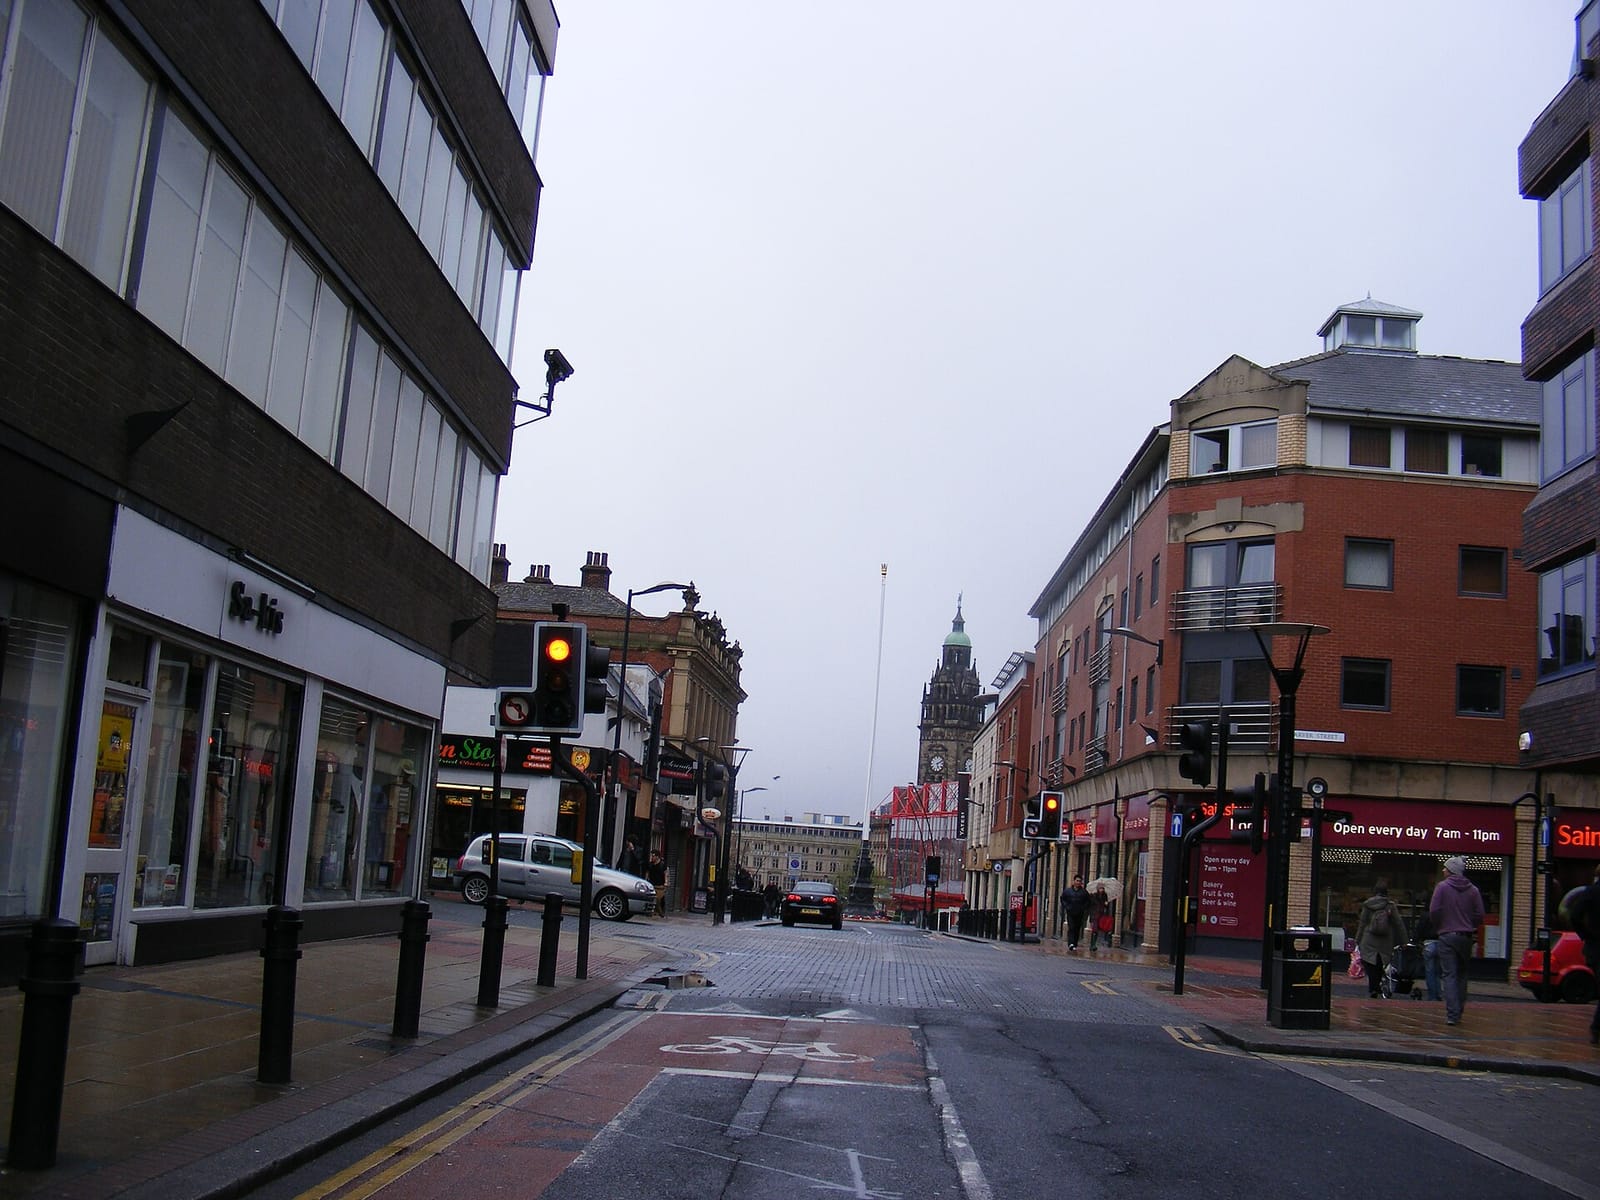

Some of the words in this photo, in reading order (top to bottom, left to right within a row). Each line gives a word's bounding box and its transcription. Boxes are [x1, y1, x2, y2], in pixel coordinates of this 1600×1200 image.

[1333, 822, 1365, 835] Open
[1368, 826, 1403, 839] every
[1405, 825, 1428, 840] day
[1434, 826, 1461, 839] 7am
[1472, 829, 1501, 842] 11pm
[1204, 855, 1220, 864] Open
[1238, 857, 1250, 866] day
[1204, 864, 1218, 872] 7am
[1202, 880, 1224, 889] Bakery
[1202, 889, 1216, 897] Fruit
[1202, 898, 1216, 906] Beer
